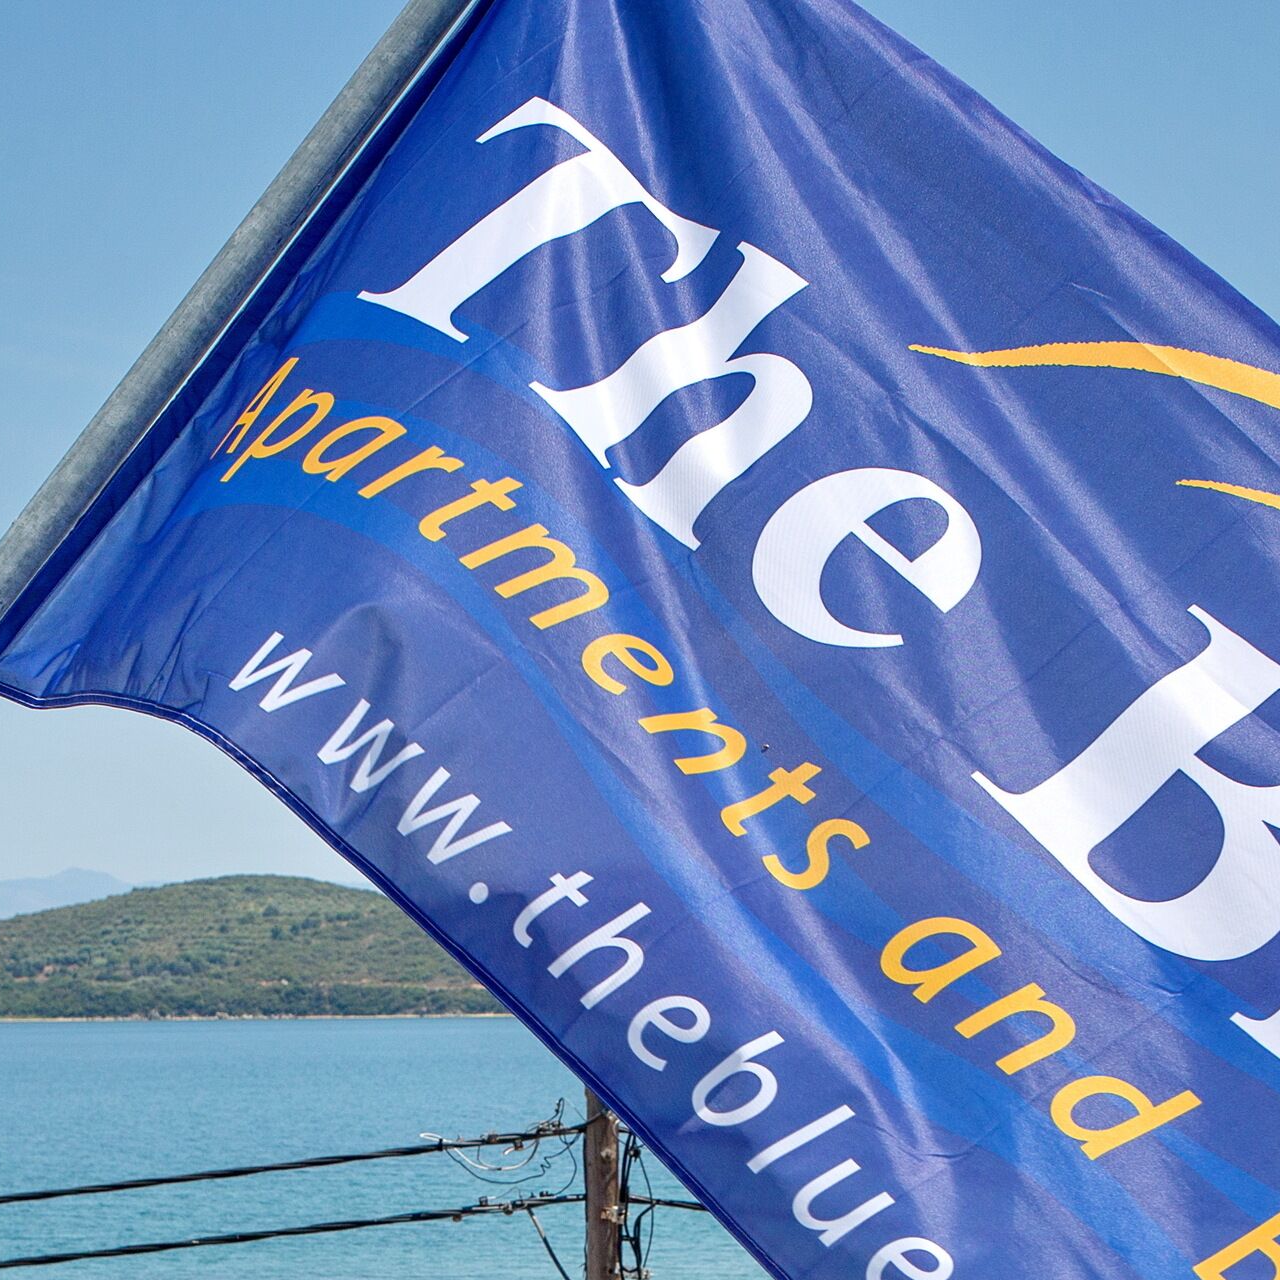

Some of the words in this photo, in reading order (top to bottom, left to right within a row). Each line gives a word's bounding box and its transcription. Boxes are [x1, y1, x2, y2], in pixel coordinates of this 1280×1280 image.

[357, 95, 983, 648] The
[210, 356, 872, 891] Apartments
[879, 916, 1203, 1161] and
